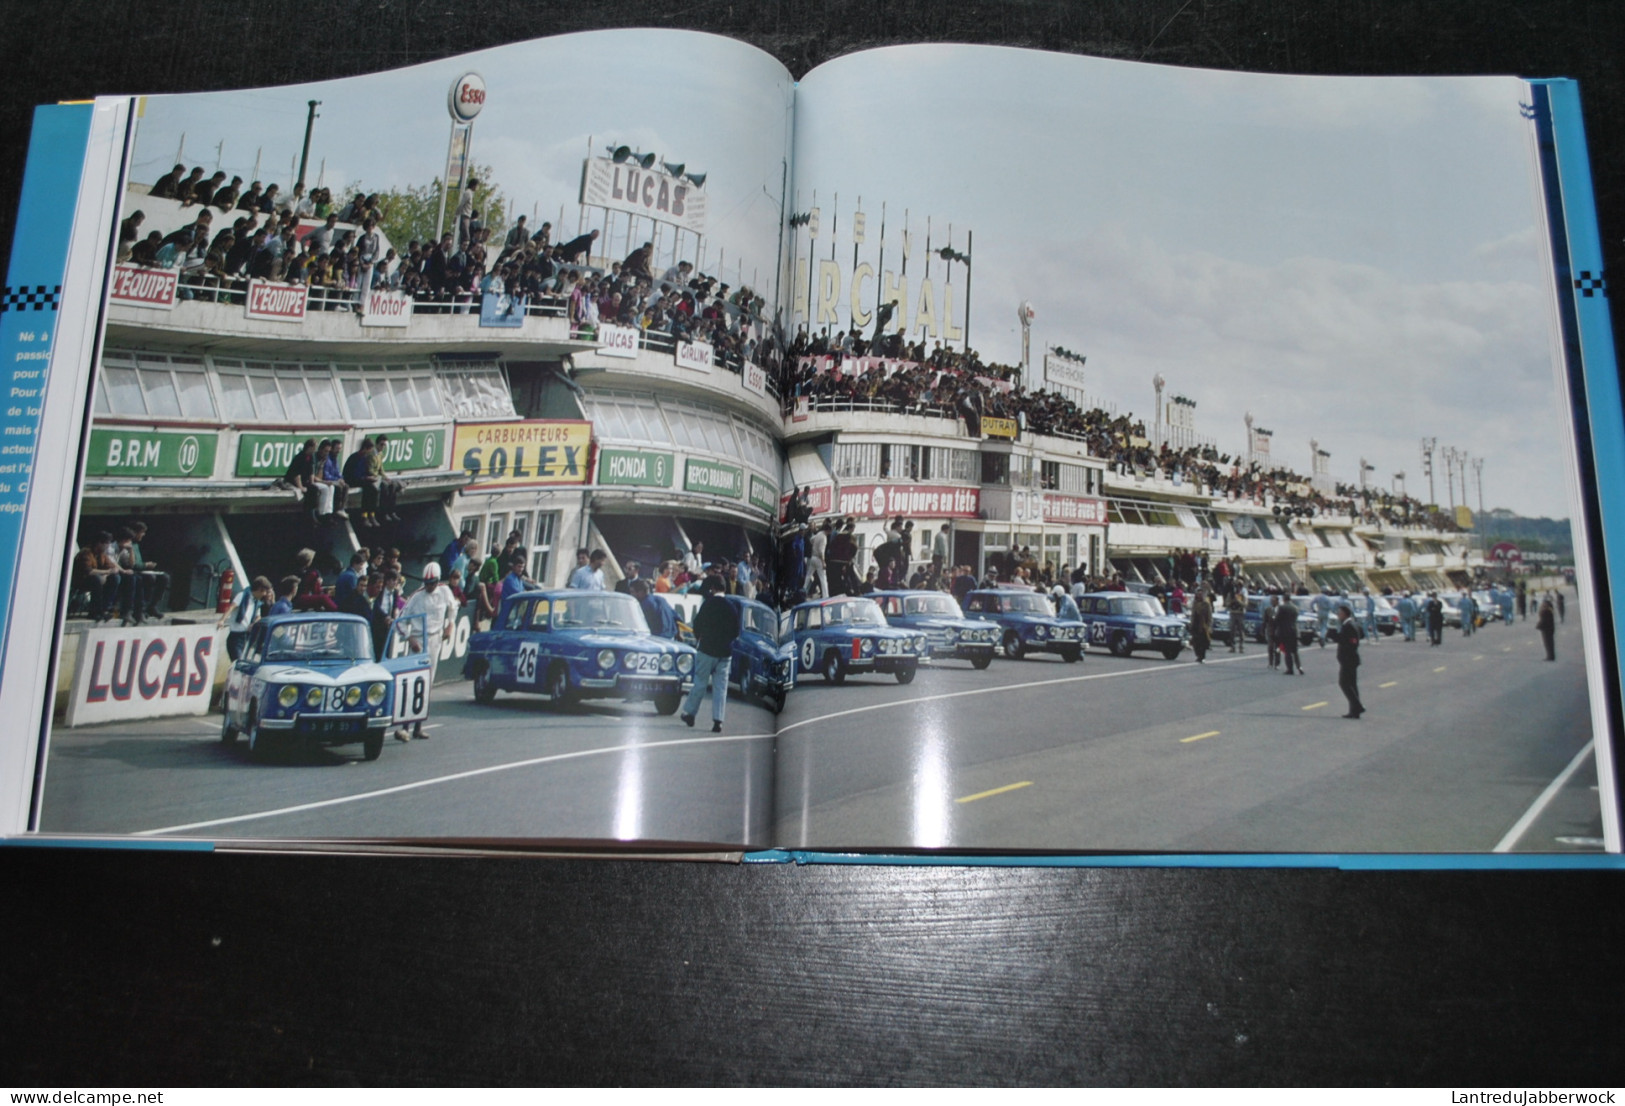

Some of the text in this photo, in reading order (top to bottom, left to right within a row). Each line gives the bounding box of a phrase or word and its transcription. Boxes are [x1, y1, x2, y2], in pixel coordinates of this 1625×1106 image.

[461, 83, 486, 104] Esso
[612, 167, 687, 217] LUCAS
[111, 269, 175, 301] L'ÉQUIPE
[252, 287, 305, 314] L'ÉQUIPE
[369, 294, 406, 315] Motor
[19, 330, 48, 342] Né à
[604, 331, 634, 349] LUCAS
[681, 344, 709, 365] GIRLING
[13, 370, 40, 381] pour
[748, 366, 763, 391] ESSO
[10, 387, 38, 398] Pour
[7, 406, 22, 416] de
[5, 425, 32, 435] mais
[477, 427, 569, 444] CARBURATEURS
[107, 438, 195, 467] B.R.M 10
[425, 442, 433, 460] 6
[463, 445, 581, 484] SOLEX
[609, 456, 647, 479] HONDA
[688, 465, 709, 486] REPCO
[841, 493, 869, 513] avec
[888, 486, 939, 516] toujours
[940, 492, 953, 512] en
[955, 488, 976, 512] tête
[518, 647, 536, 679] 26
[805, 642, 812, 666] 3
[86, 636, 214, 703] LUCAS
[323, 686, 344, 711] 18
[400, 676, 425, 717] 18
